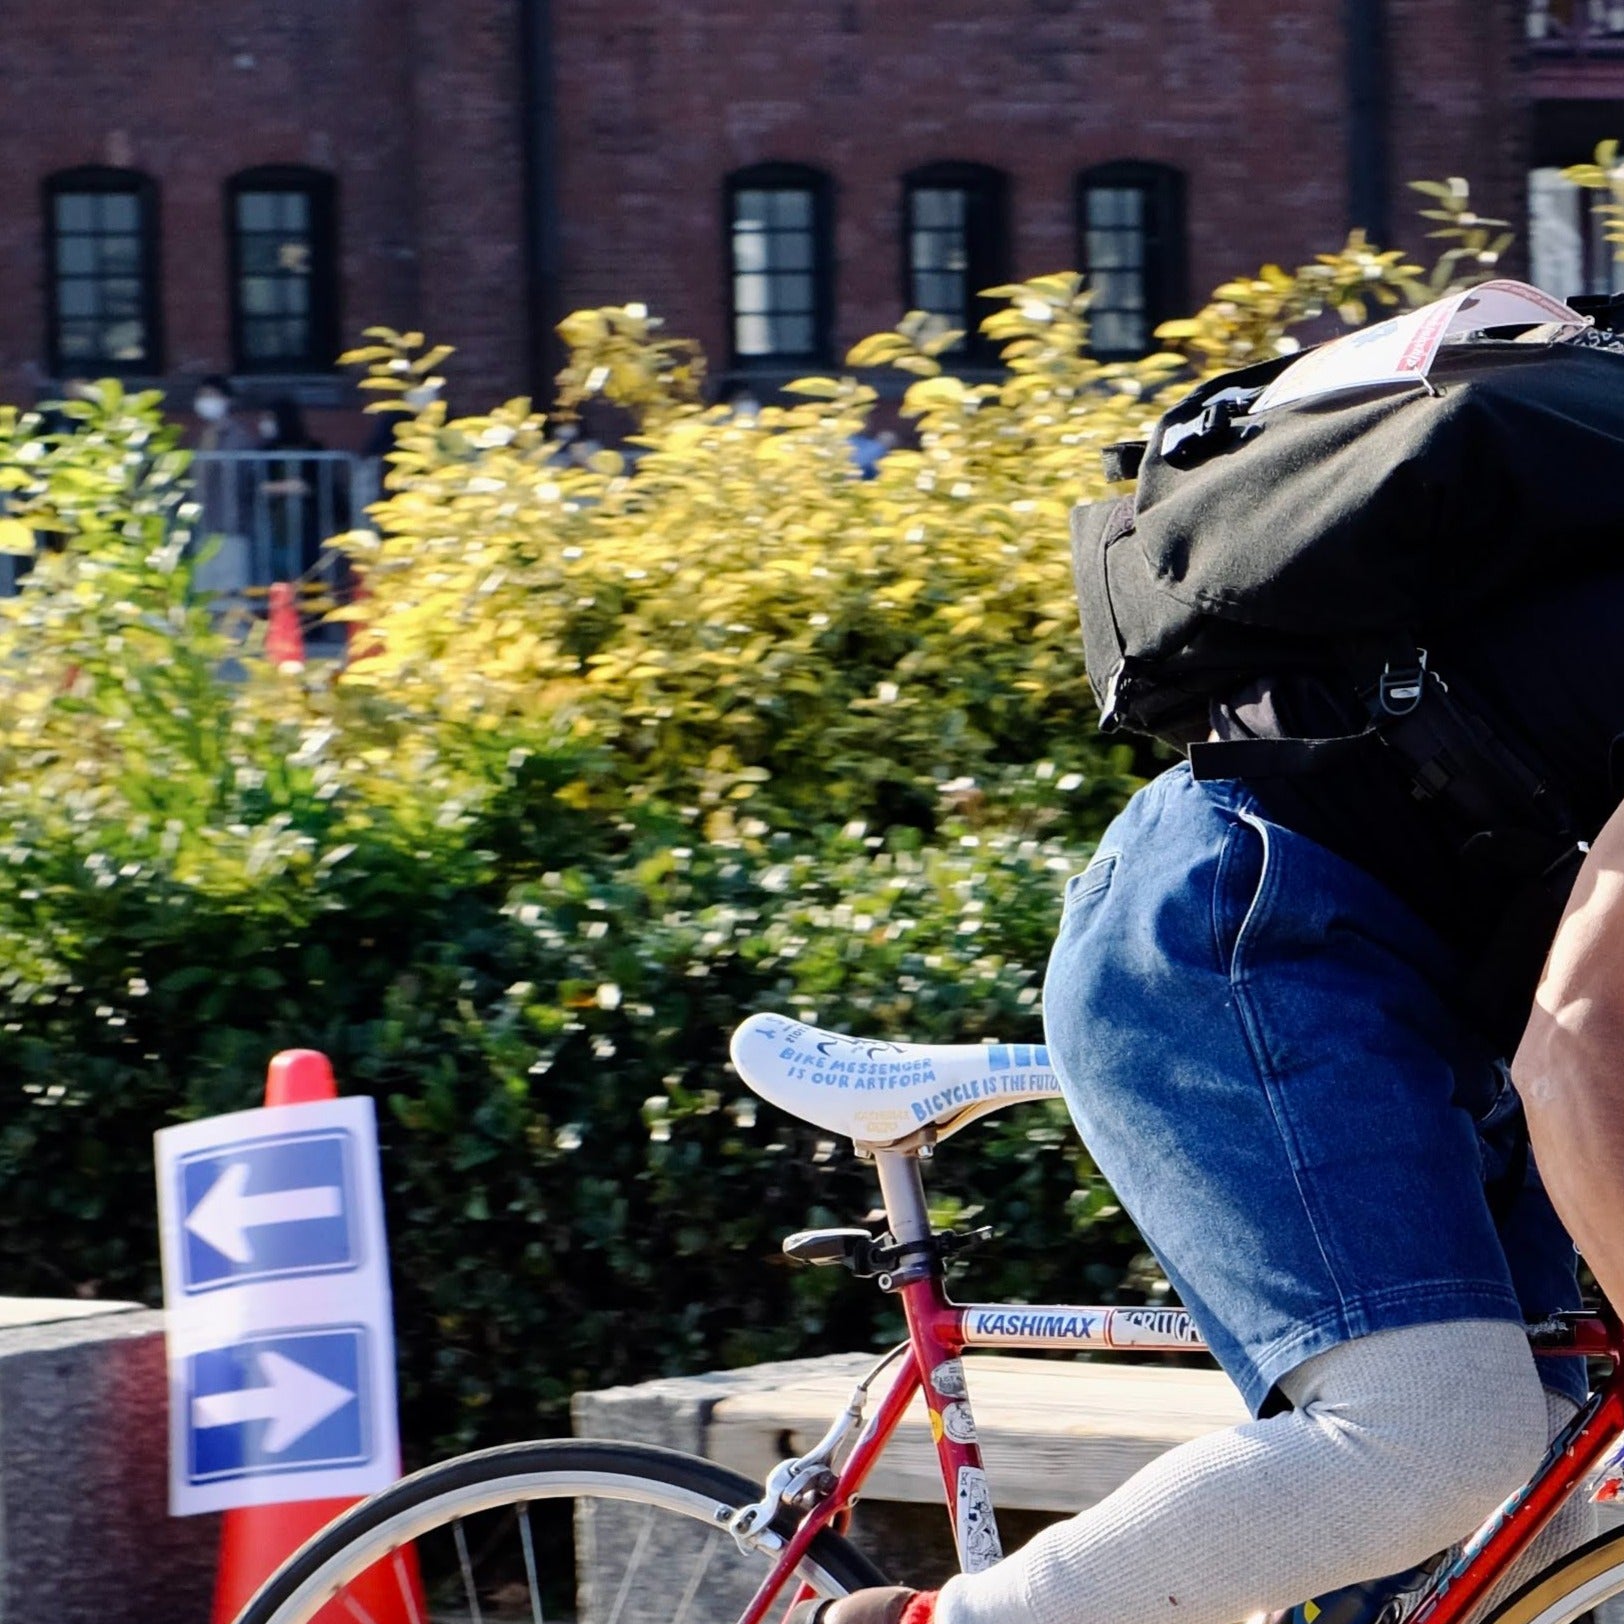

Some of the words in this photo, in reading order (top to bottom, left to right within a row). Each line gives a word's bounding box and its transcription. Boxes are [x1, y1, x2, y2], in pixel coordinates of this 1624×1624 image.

[779, 1047, 827, 1068] BIKE
[829, 1058, 932, 1075] MESSENGER
[788, 1067, 806, 1079] IS
[811, 1072, 849, 1088] OUR
[854, 1071, 936, 1090] ARTFORM
[911, 1080, 980, 1122] BICYCLE
[983, 1076, 997, 1095] IS
[1001, 1074, 1026, 1092] THE
[1029, 1074, 1061, 1092] FUTU
[976, 1314, 1096, 1339] KASHIMAX
